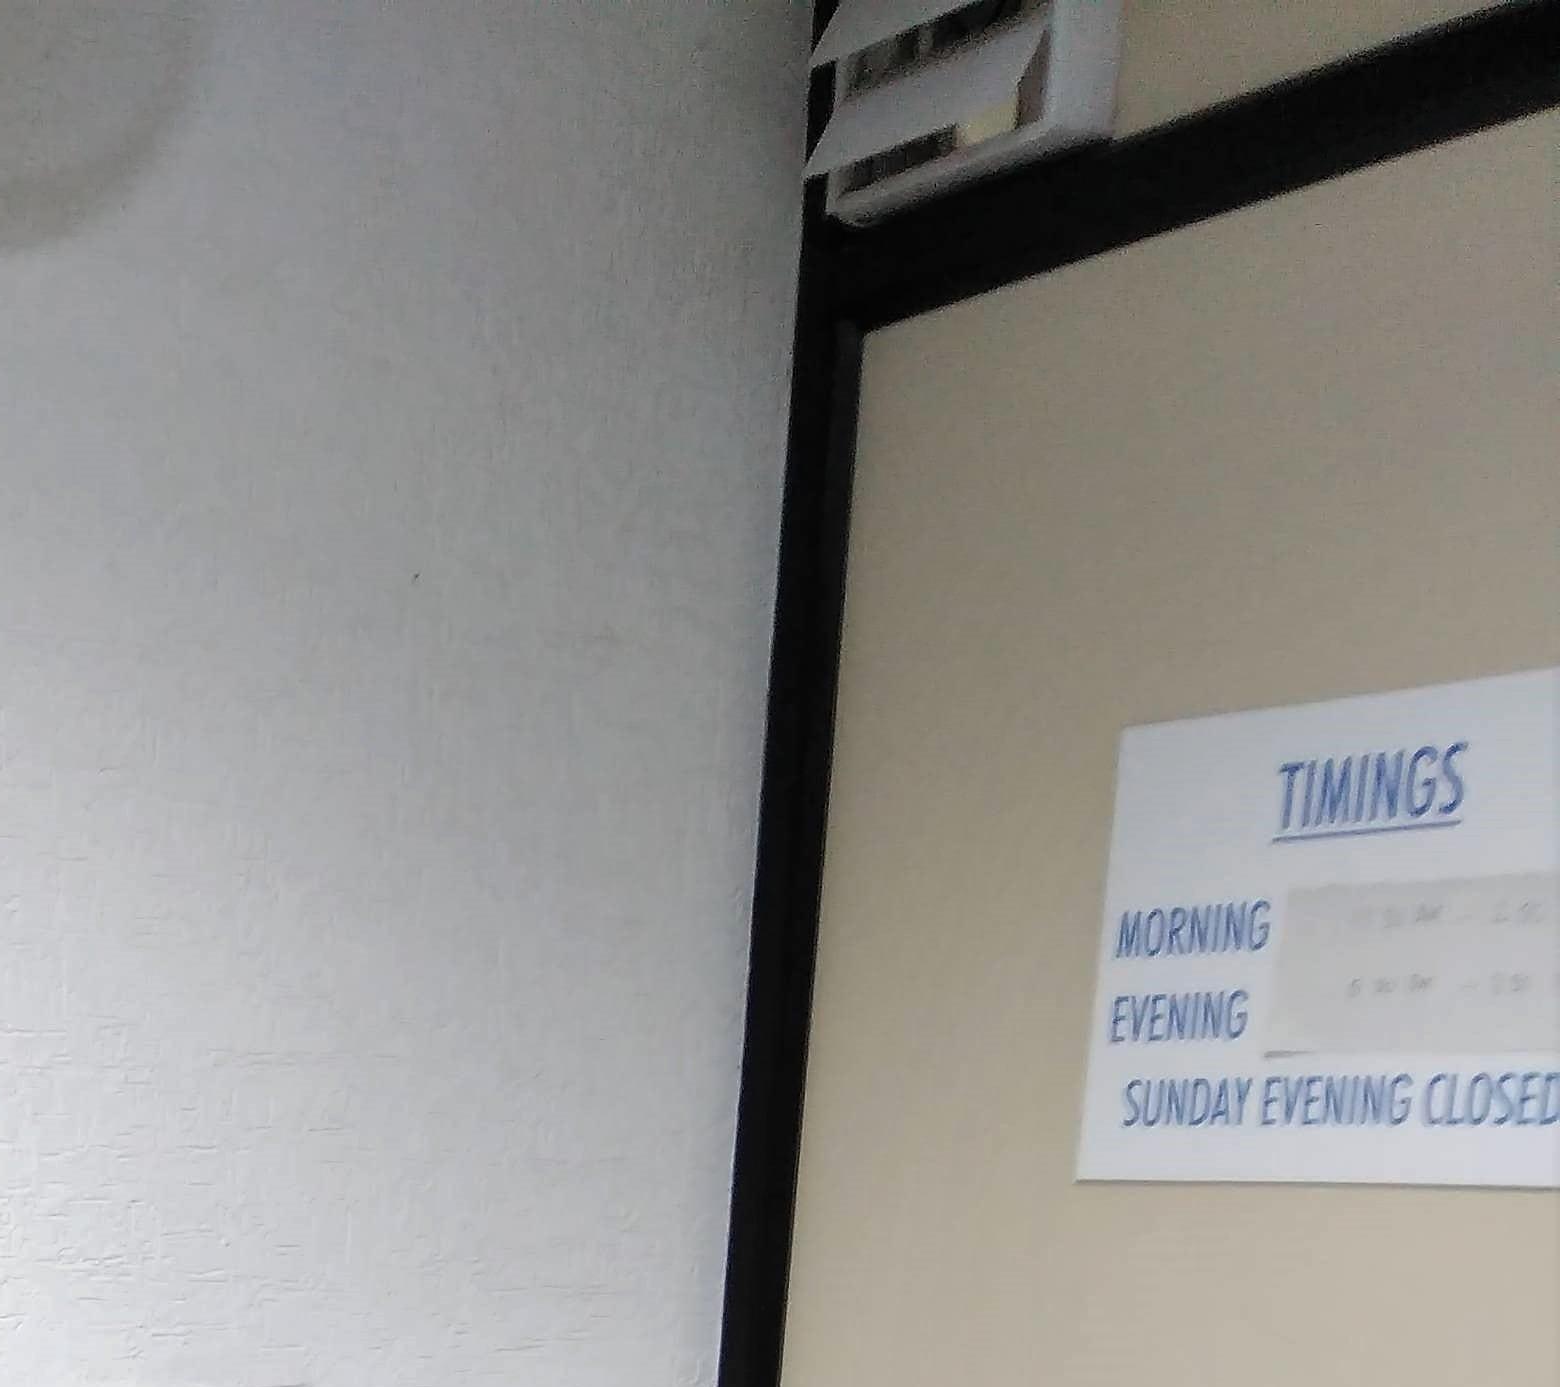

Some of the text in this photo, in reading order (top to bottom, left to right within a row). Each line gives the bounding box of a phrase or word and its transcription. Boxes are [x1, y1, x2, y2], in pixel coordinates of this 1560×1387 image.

[1278, 741, 1469, 830] TIMINGS
[1115, 899, 1272, 959] MORNING
[1109, 989, 1250, 1043] EVENING
[1121, 1072, 1560, 1128] SUNDAY EVENING CLOSED
